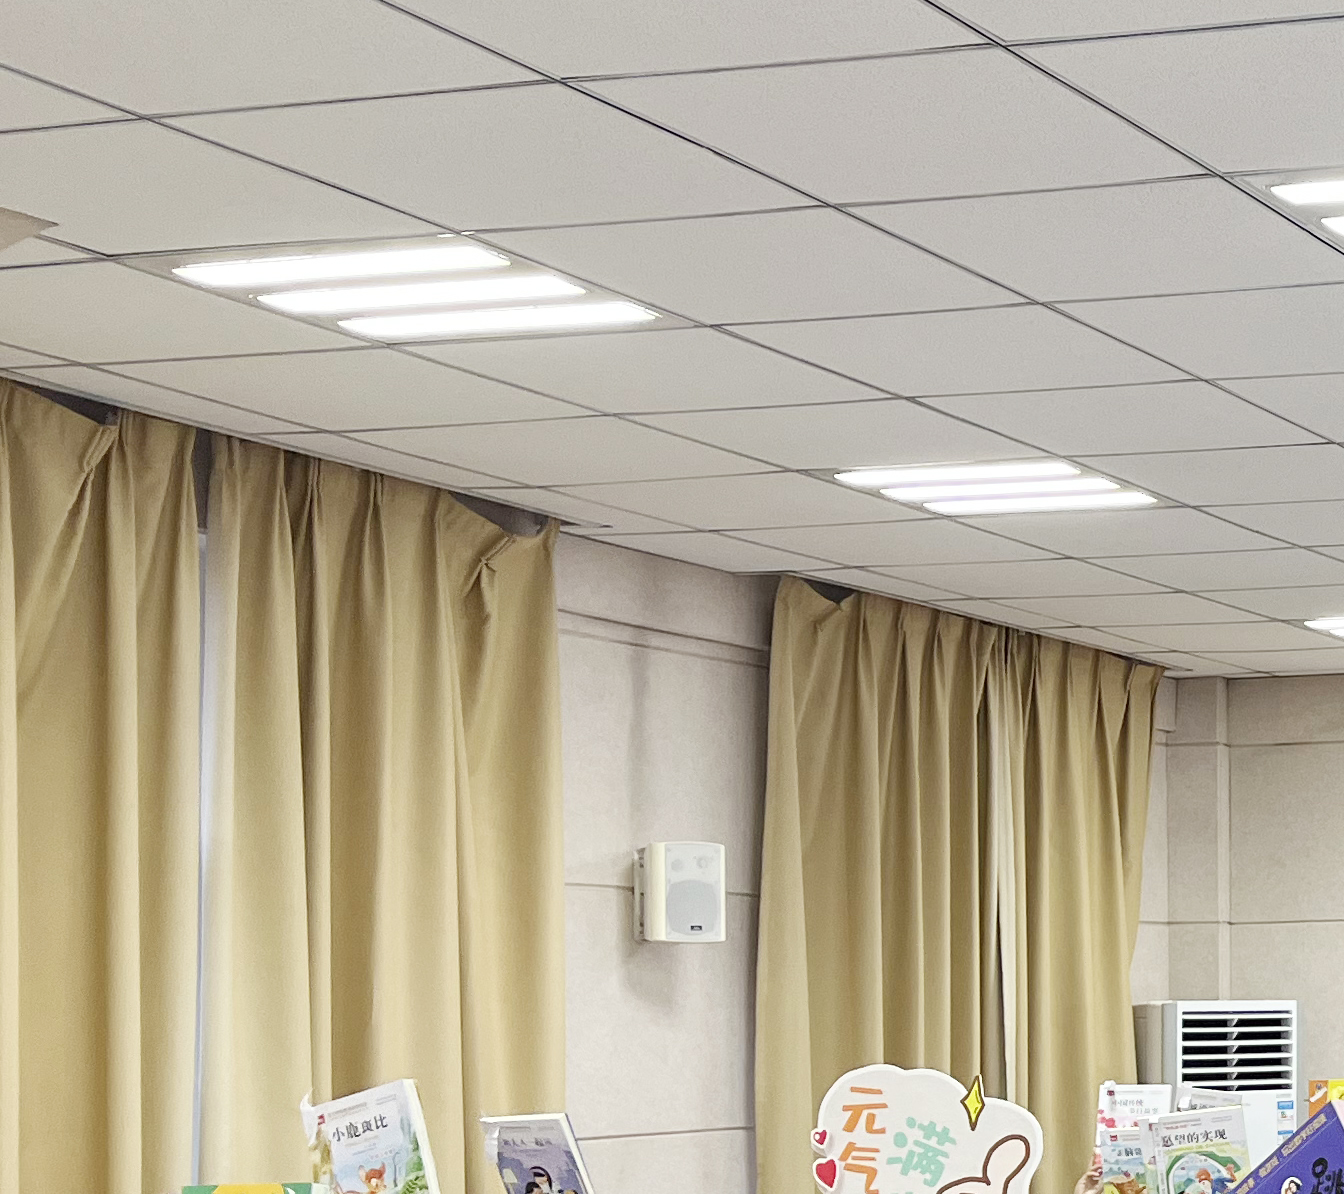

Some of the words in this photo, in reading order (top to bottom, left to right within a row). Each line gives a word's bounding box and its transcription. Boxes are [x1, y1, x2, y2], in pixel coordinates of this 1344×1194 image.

[1161, 1128, 1228, 1148] 愿望的实现
